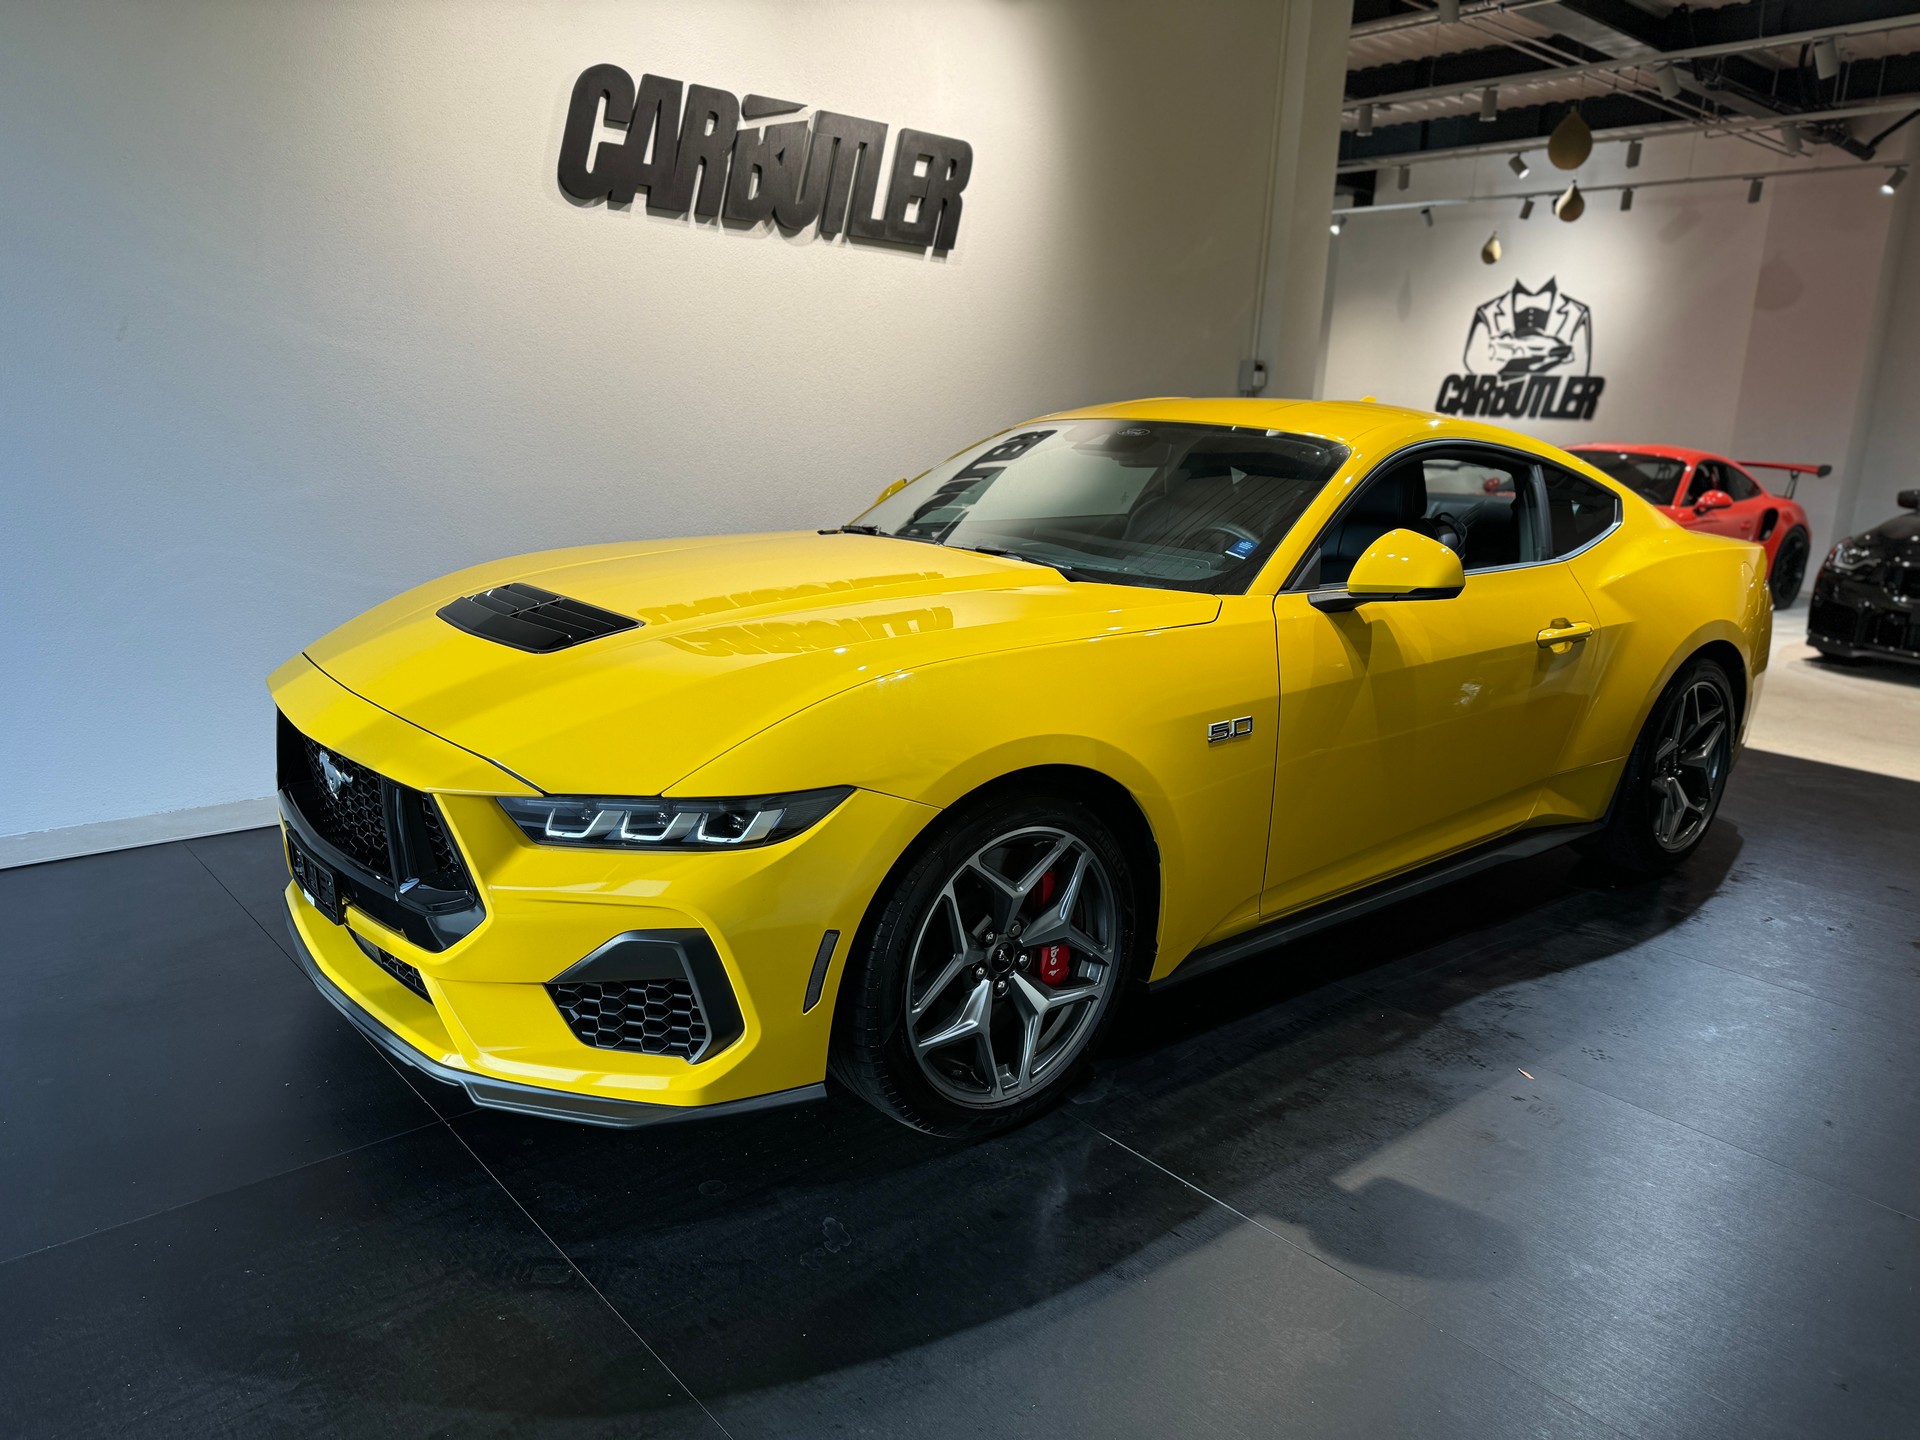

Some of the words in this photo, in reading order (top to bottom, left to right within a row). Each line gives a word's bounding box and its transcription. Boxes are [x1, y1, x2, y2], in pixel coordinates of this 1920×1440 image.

[557, 64, 973, 252] CARBUTLER
[1435, 374, 1606, 421] CARBUTLER
[1207, 715, 1254, 743] 5.0
